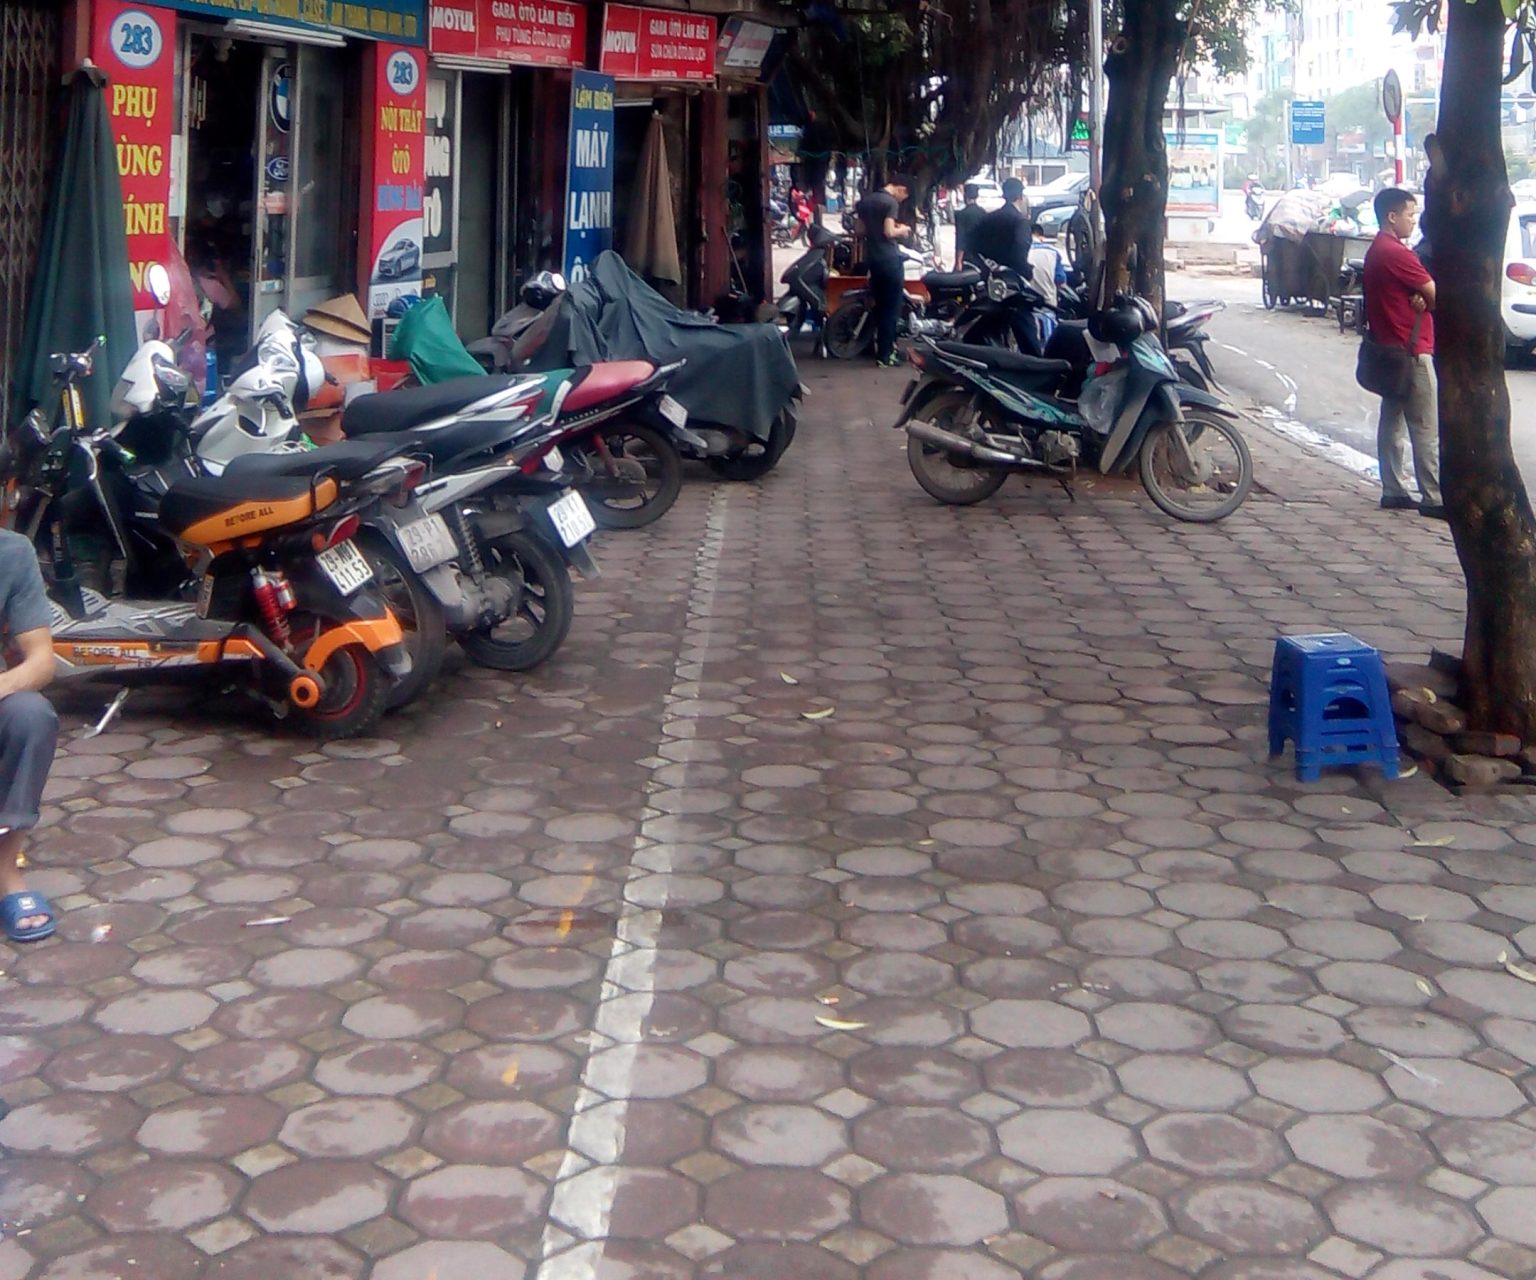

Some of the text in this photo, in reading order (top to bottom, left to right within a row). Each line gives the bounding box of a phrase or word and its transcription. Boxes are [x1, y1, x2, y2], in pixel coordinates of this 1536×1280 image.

[432, 6, 475, 32] MOTUL
[492, 0, 516, 20] GARA
[120, 23, 152, 55] 283
[604, 30, 636, 53] MOTUL
[393, 61, 413, 85] 283
[112, 84, 157, 128] PHỤ
[381, 100, 398, 138] NỘI
[116, 134, 162, 176] ÙNG
[576, 122, 609, 168] MÁY
[569, 191, 611, 238] LẠNH
[225, 506, 274, 527] BEFORE ALL
[73, 646, 138, 657] BEFORE ALL
